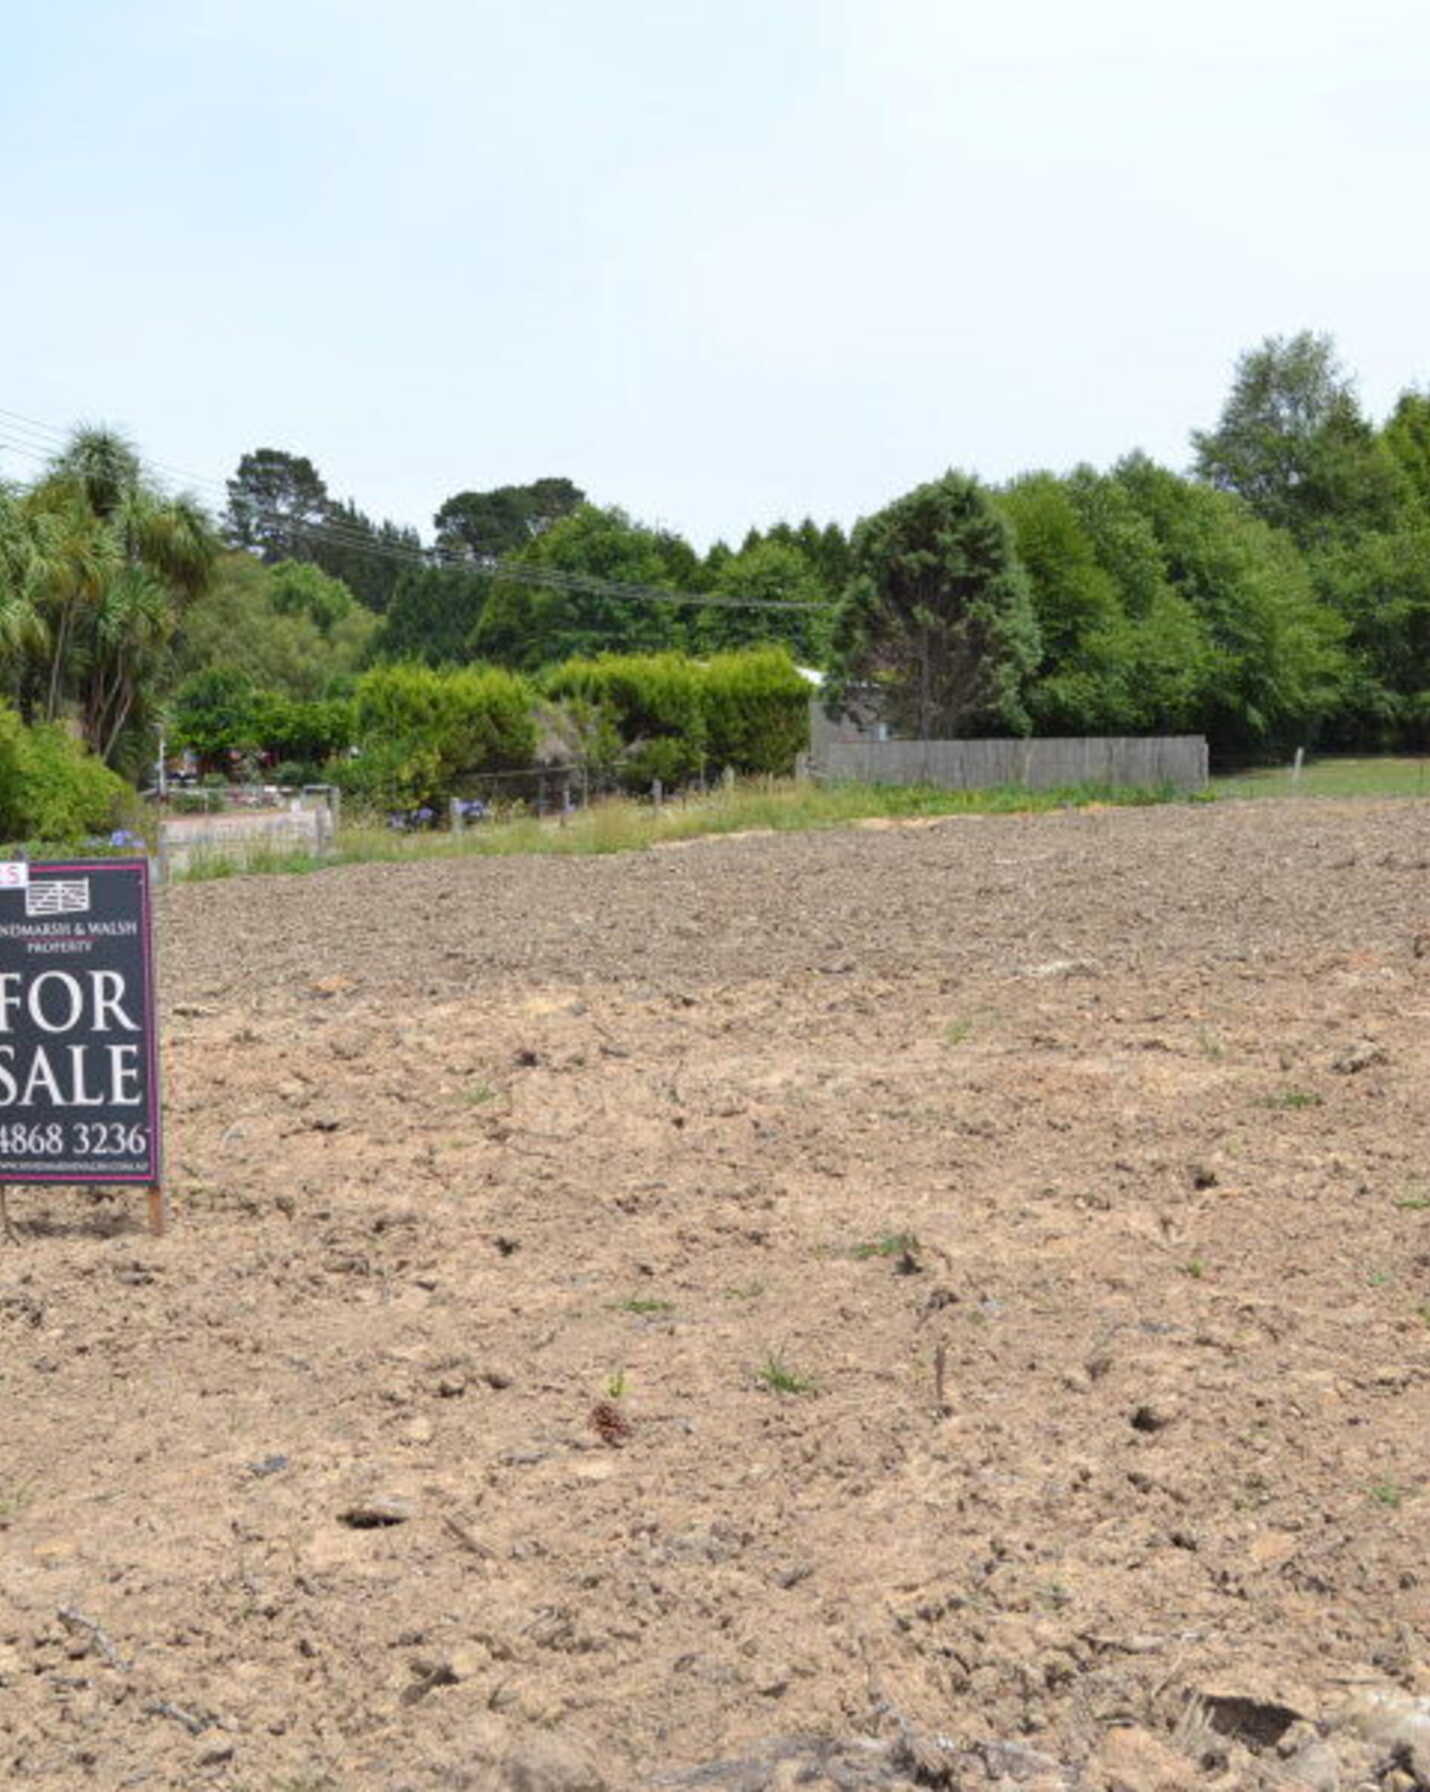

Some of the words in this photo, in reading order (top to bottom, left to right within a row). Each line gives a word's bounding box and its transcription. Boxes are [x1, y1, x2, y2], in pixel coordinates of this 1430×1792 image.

[75, 922, 86, 935] &
[88, 921, 137, 935] WALSH
[27, 941, 93, 953] PROPERTY
[0, 970, 142, 1033] FOR
[0, 1043, 142, 1106] SALE
[0, 1122, 63, 1154] 4868
[72, 1122, 147, 1154] 3236
